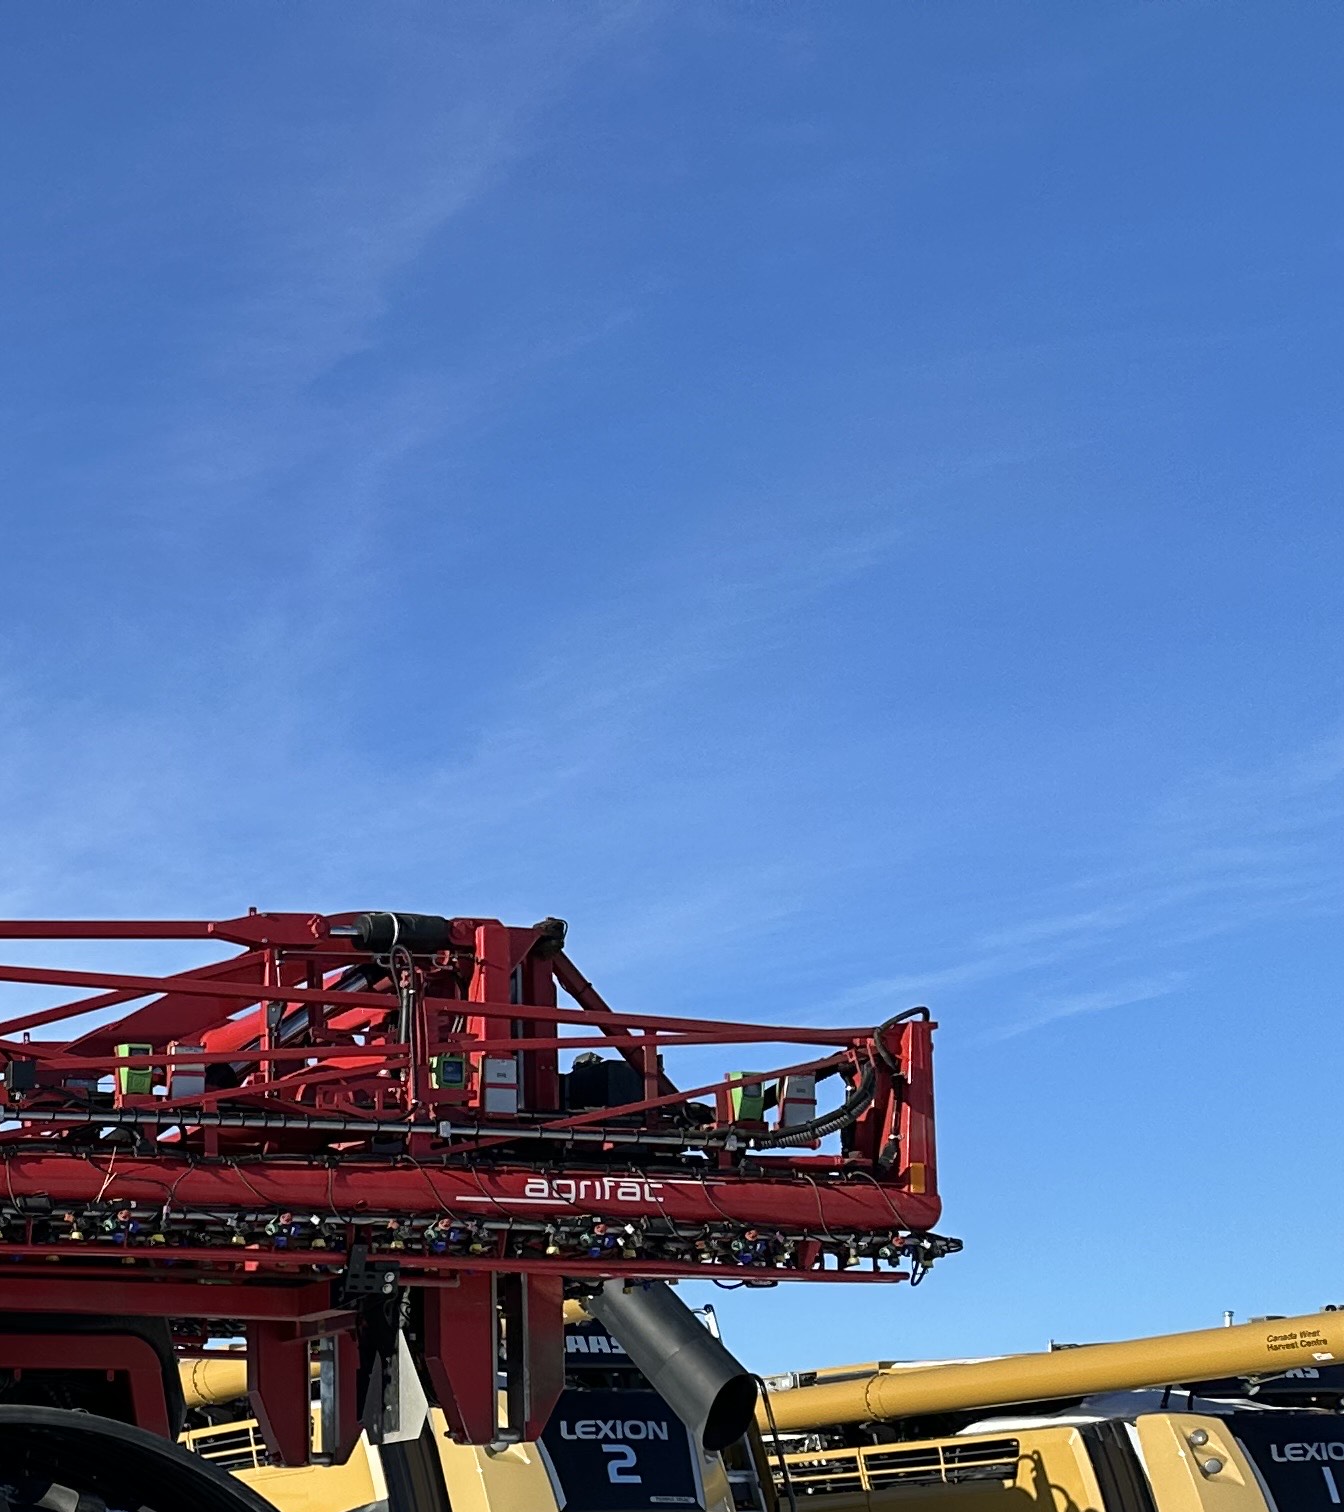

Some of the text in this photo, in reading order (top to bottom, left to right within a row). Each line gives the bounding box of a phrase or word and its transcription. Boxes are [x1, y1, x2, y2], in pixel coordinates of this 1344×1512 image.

[1267, 1330, 1321, 1343] Canada West
[1267, 1338, 1328, 1352] Harvest Centre
[560, 1420, 669, 1440] LEXION
[1270, 1442, 1344, 1462] LEXIO
[601, 1443, 643, 1484] 2
